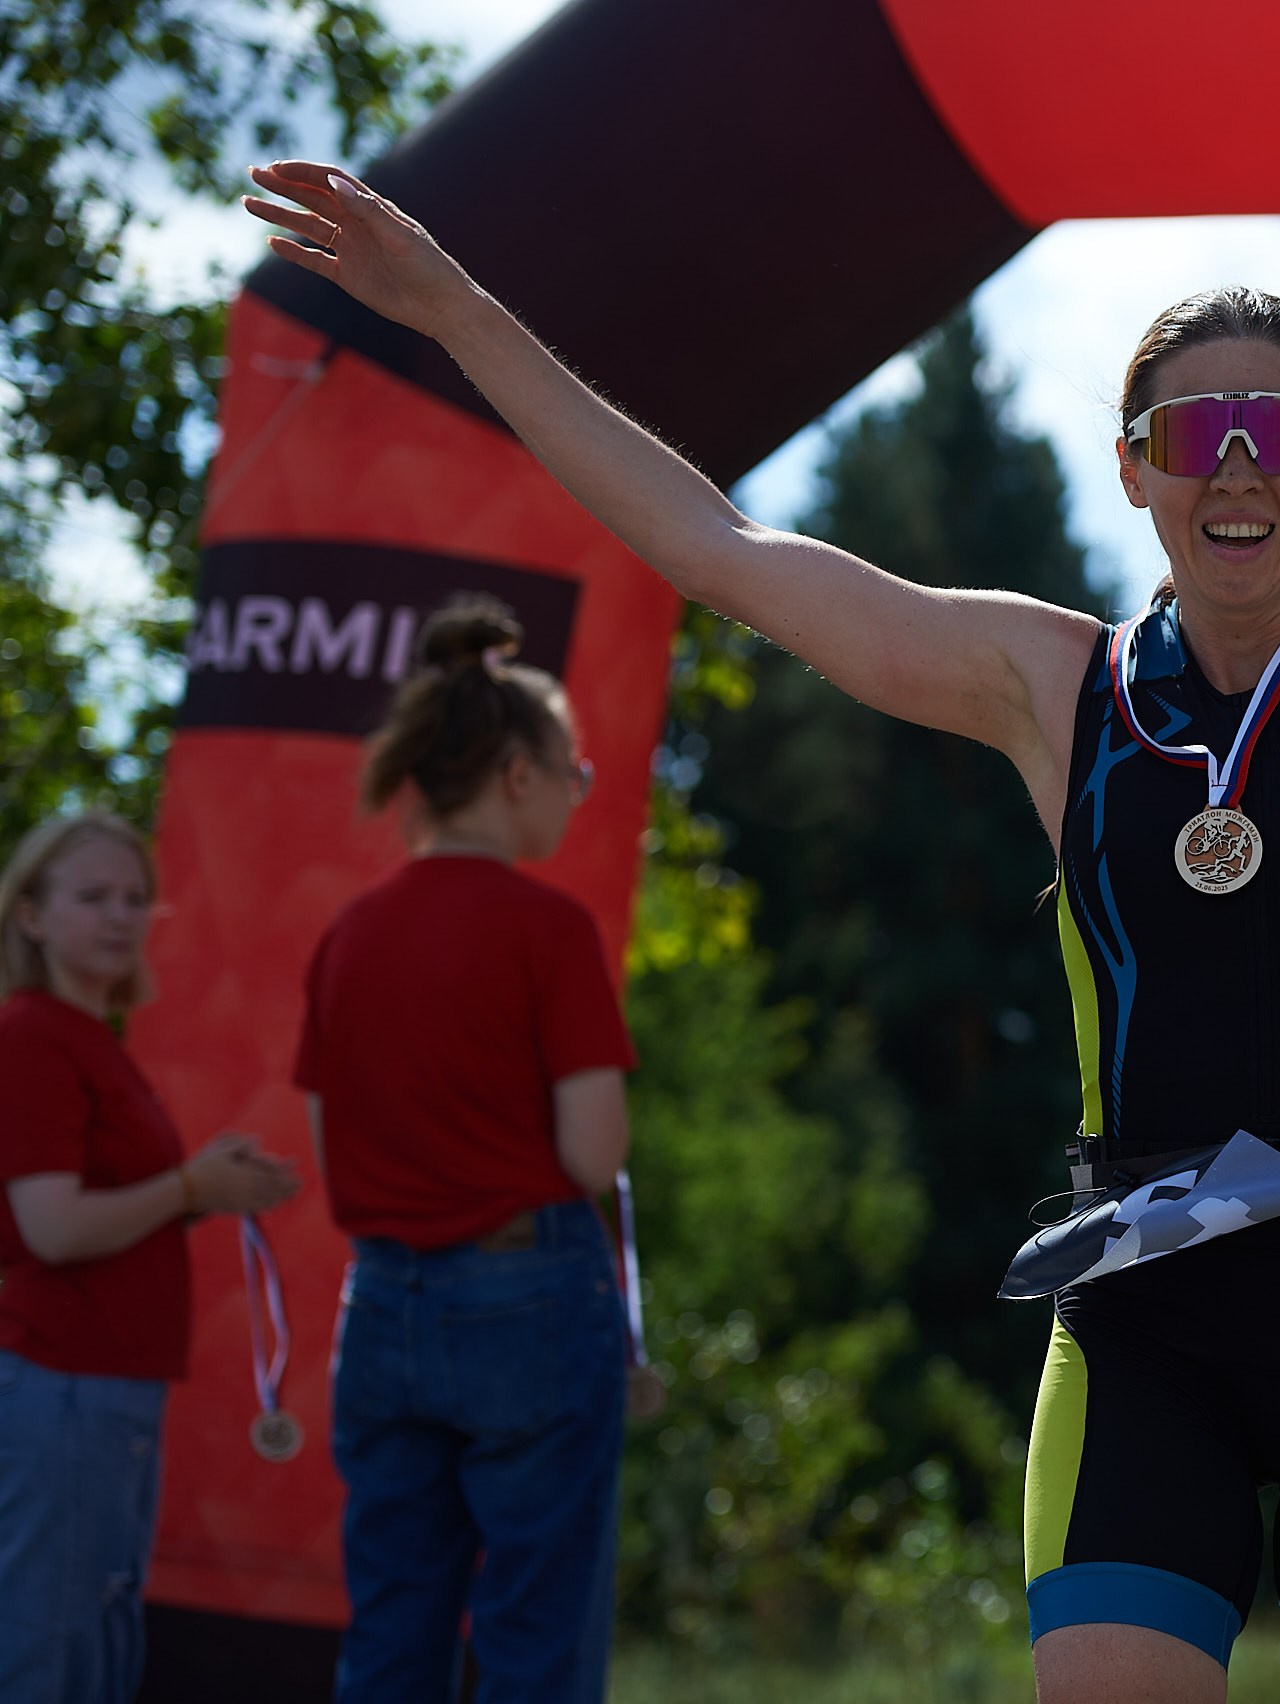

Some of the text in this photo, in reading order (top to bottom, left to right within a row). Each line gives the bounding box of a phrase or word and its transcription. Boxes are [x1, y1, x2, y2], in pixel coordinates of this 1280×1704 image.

[185, 594, 420, 684] ARMI
[1184, 810, 1260, 843] ТРИАТЛОН МОЖГАМЭН
